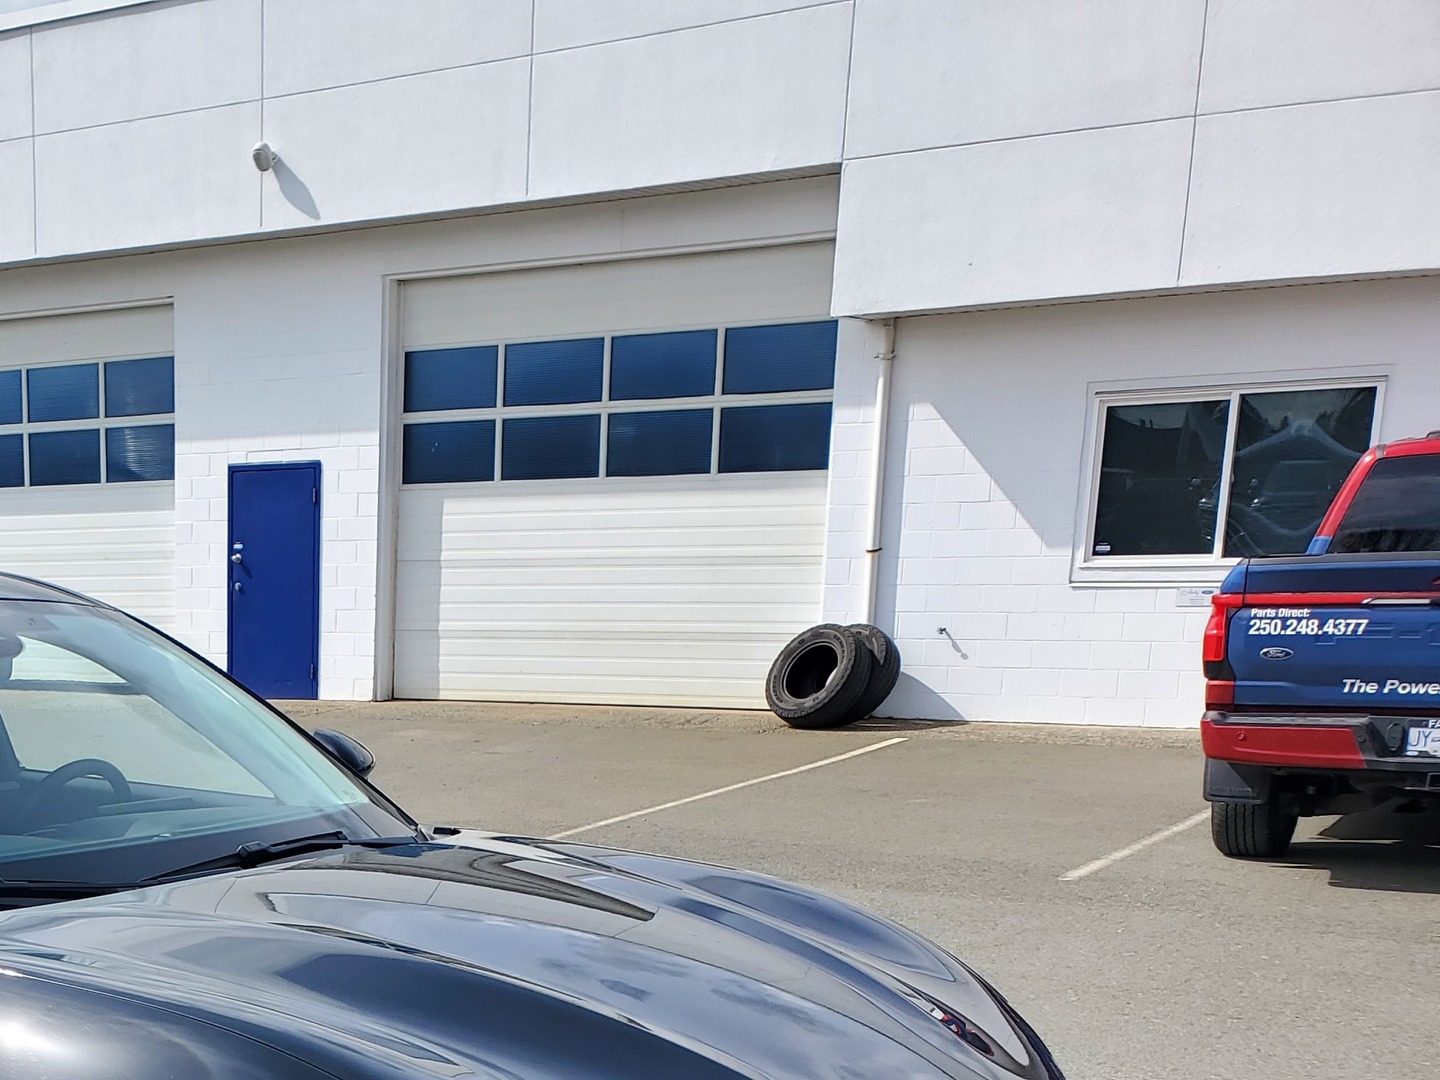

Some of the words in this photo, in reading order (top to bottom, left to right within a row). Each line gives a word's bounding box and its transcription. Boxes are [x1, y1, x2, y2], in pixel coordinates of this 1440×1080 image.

[1250, 608, 1276, 618] Parts
[1278, 608, 1311, 618] Direct:
[1248, 619, 1368, 635] 250.248.4377
[1342, 678, 1379, 694] The
